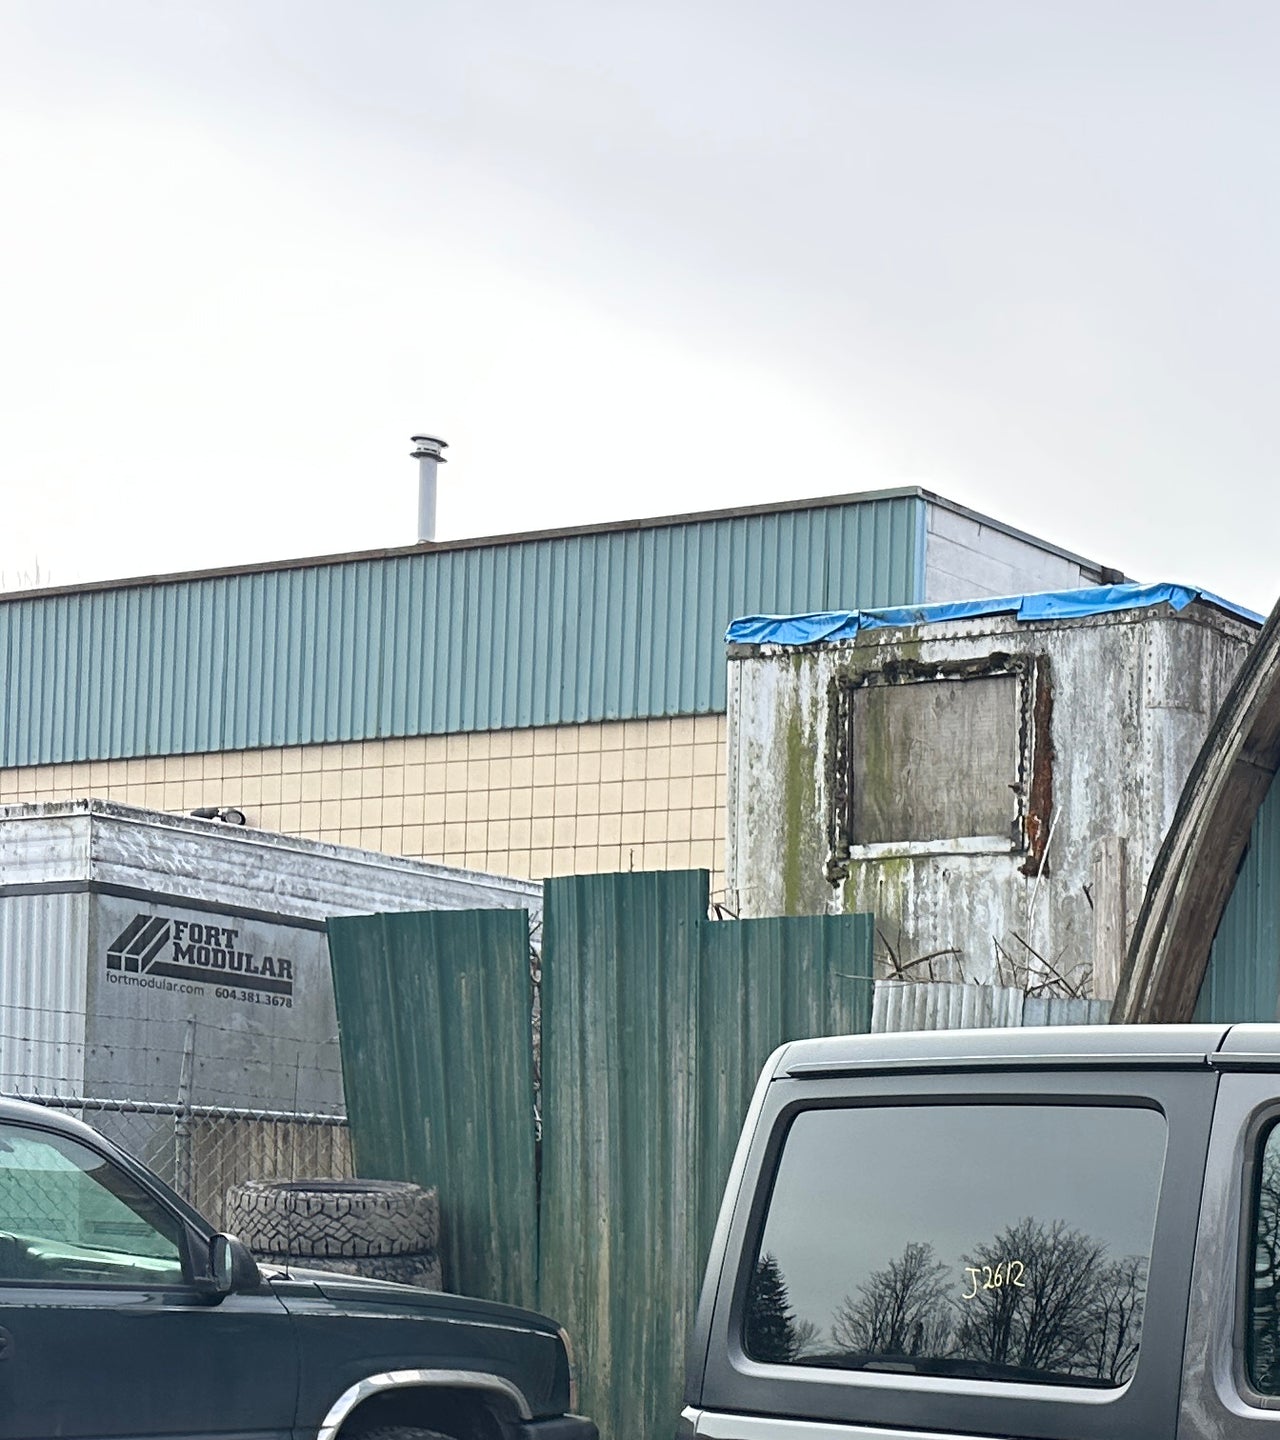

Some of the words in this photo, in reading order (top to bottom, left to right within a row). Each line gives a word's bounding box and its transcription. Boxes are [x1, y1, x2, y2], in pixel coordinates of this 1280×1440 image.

[173, 920, 238, 949] FORT
[172, 942, 293, 979] MODULAR
[106, 971, 204, 996] fortmodular.com
[215, 987, 292, 1008] 604.381.3678
[962, 1260, 1025, 1299] J2612
